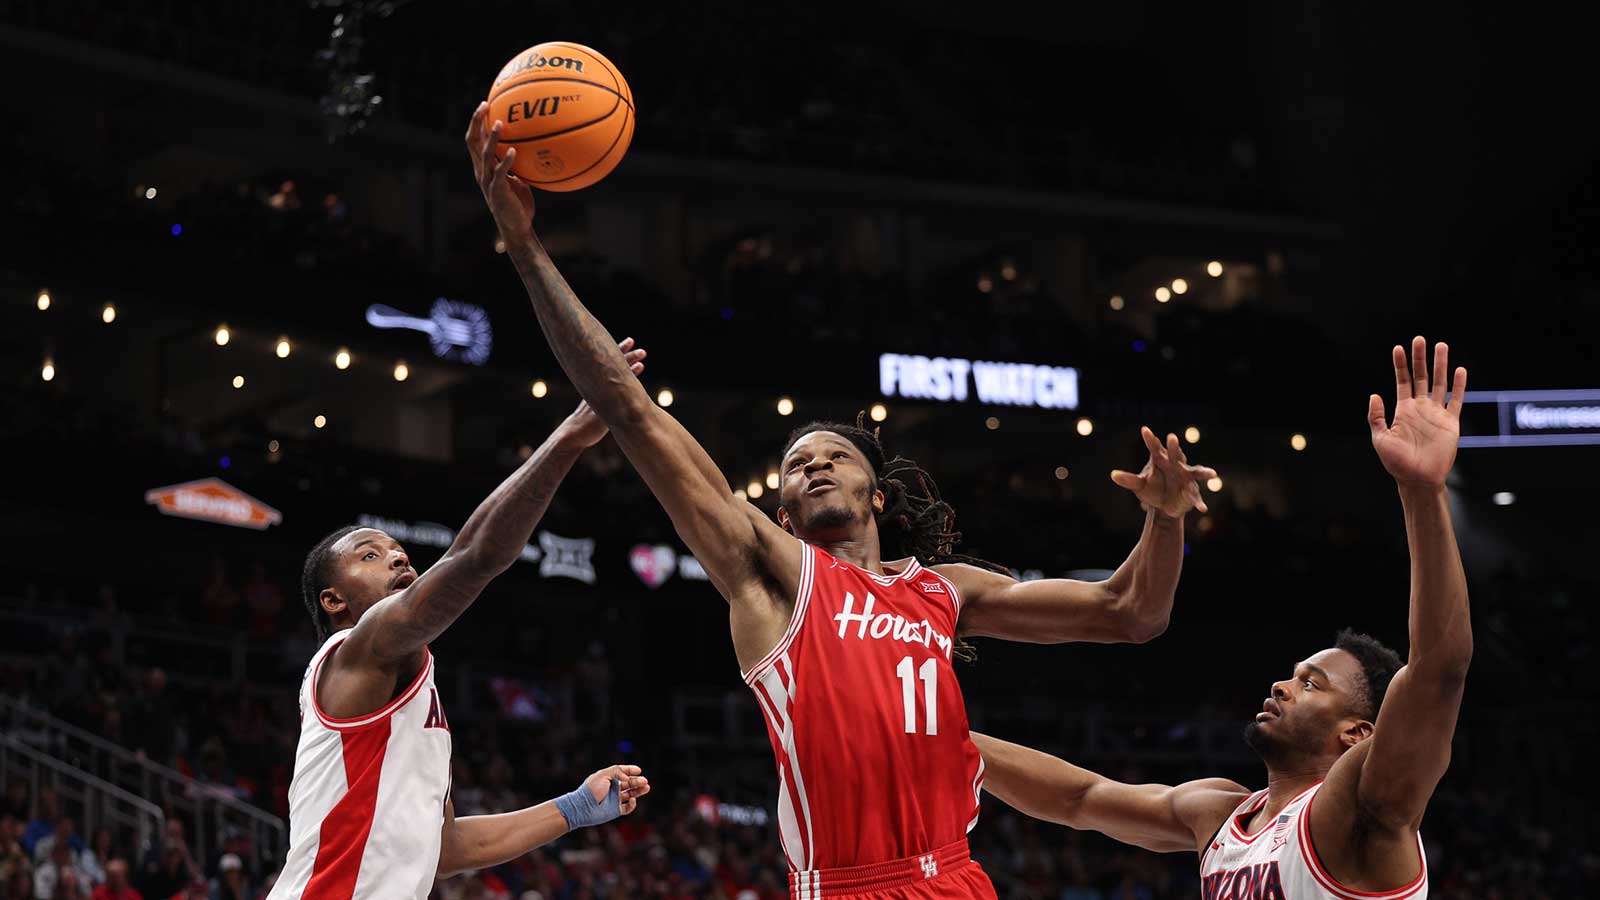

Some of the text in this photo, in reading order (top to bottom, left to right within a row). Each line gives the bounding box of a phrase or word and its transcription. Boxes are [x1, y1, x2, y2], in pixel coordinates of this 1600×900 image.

[508, 96, 560, 123] EVO
[879, 353, 1079, 409] FIRST WATCH
[896, 656, 938, 736] 11
